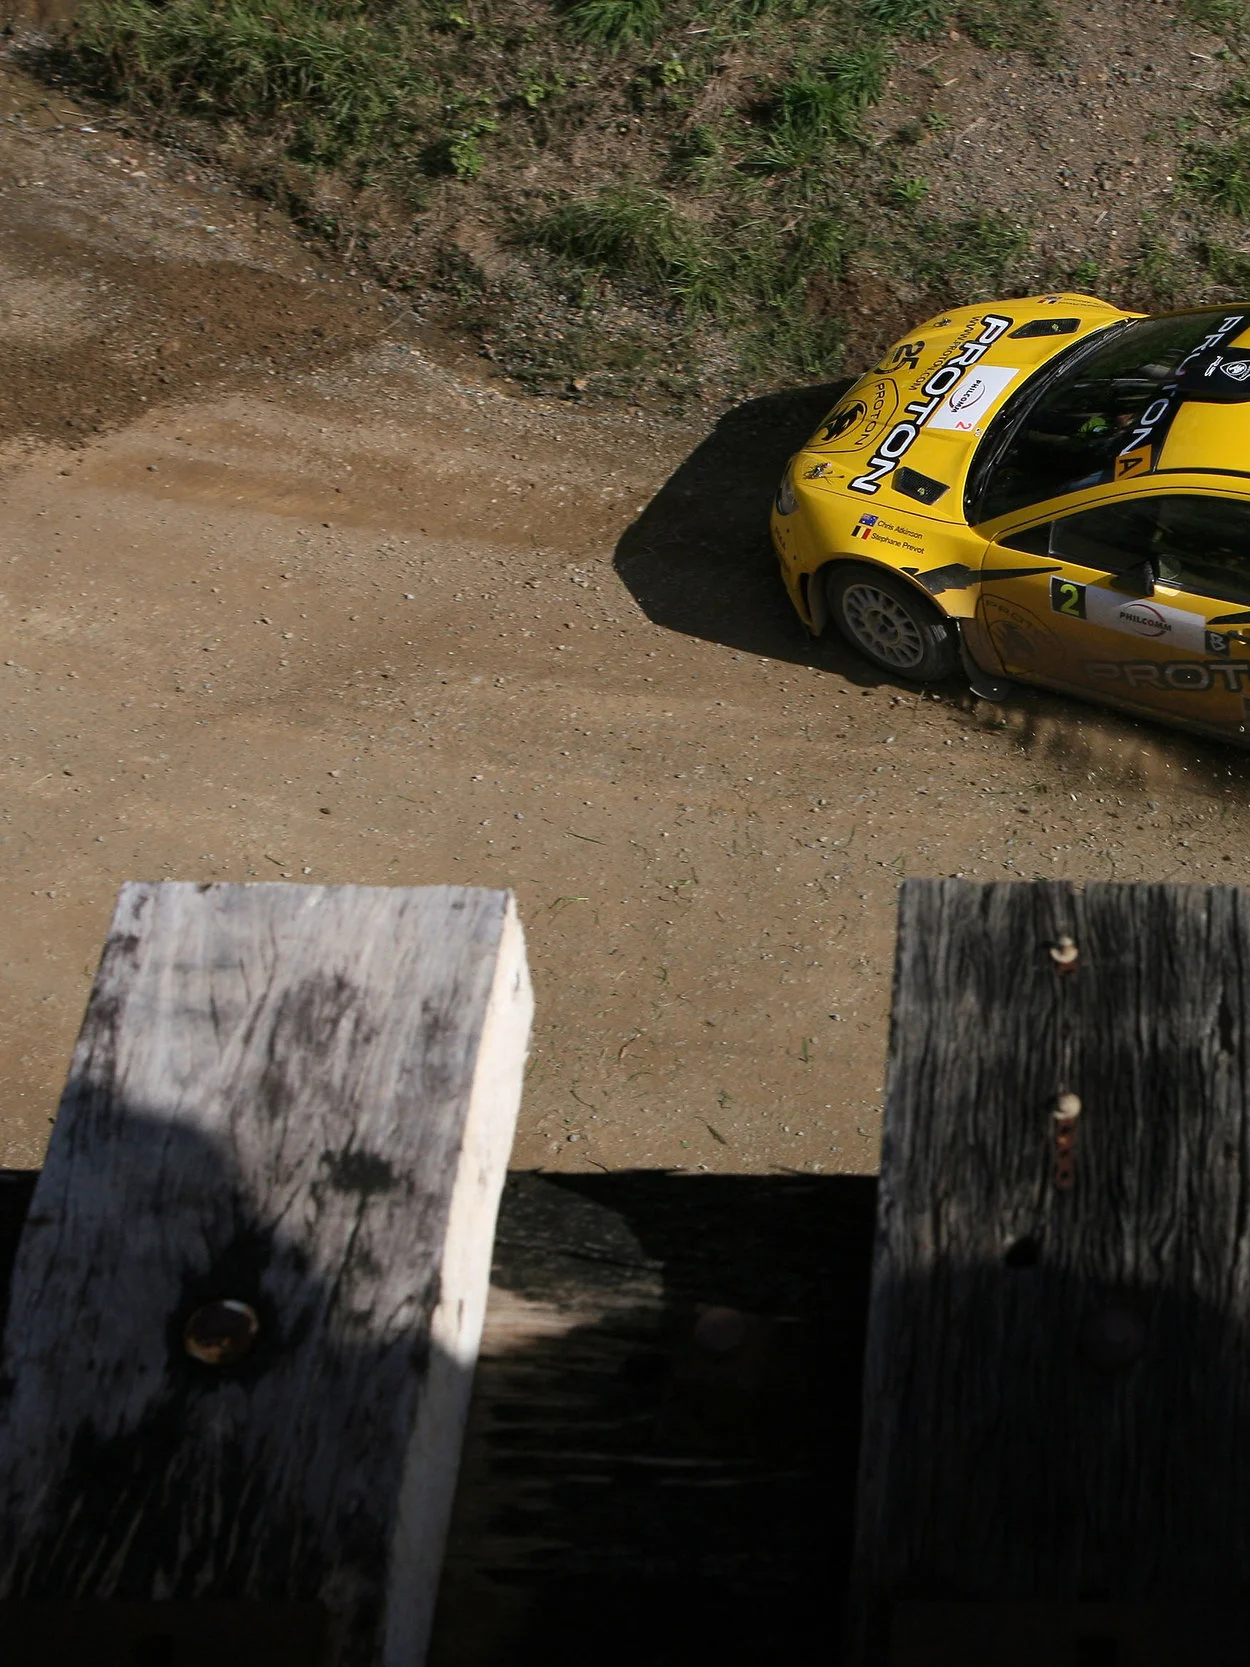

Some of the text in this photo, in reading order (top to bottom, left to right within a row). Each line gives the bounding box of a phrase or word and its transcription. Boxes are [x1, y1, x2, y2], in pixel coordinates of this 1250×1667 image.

[874, 341, 925, 374] 25
[849, 315, 1011, 492] PROTON
[951, 380, 981, 412] PHILCOMM
[854, 383, 885, 445] PROTON
[955, 421, 972, 429] 2
[1119, 458, 1143, 477] A
[878, 520, 923, 540] Chris Atkinson
[871, 533, 925, 555] Stephane Prevot
[1059, 584, 1080, 616] 2
[1119, 611, 1173, 632] PHILCOMM
